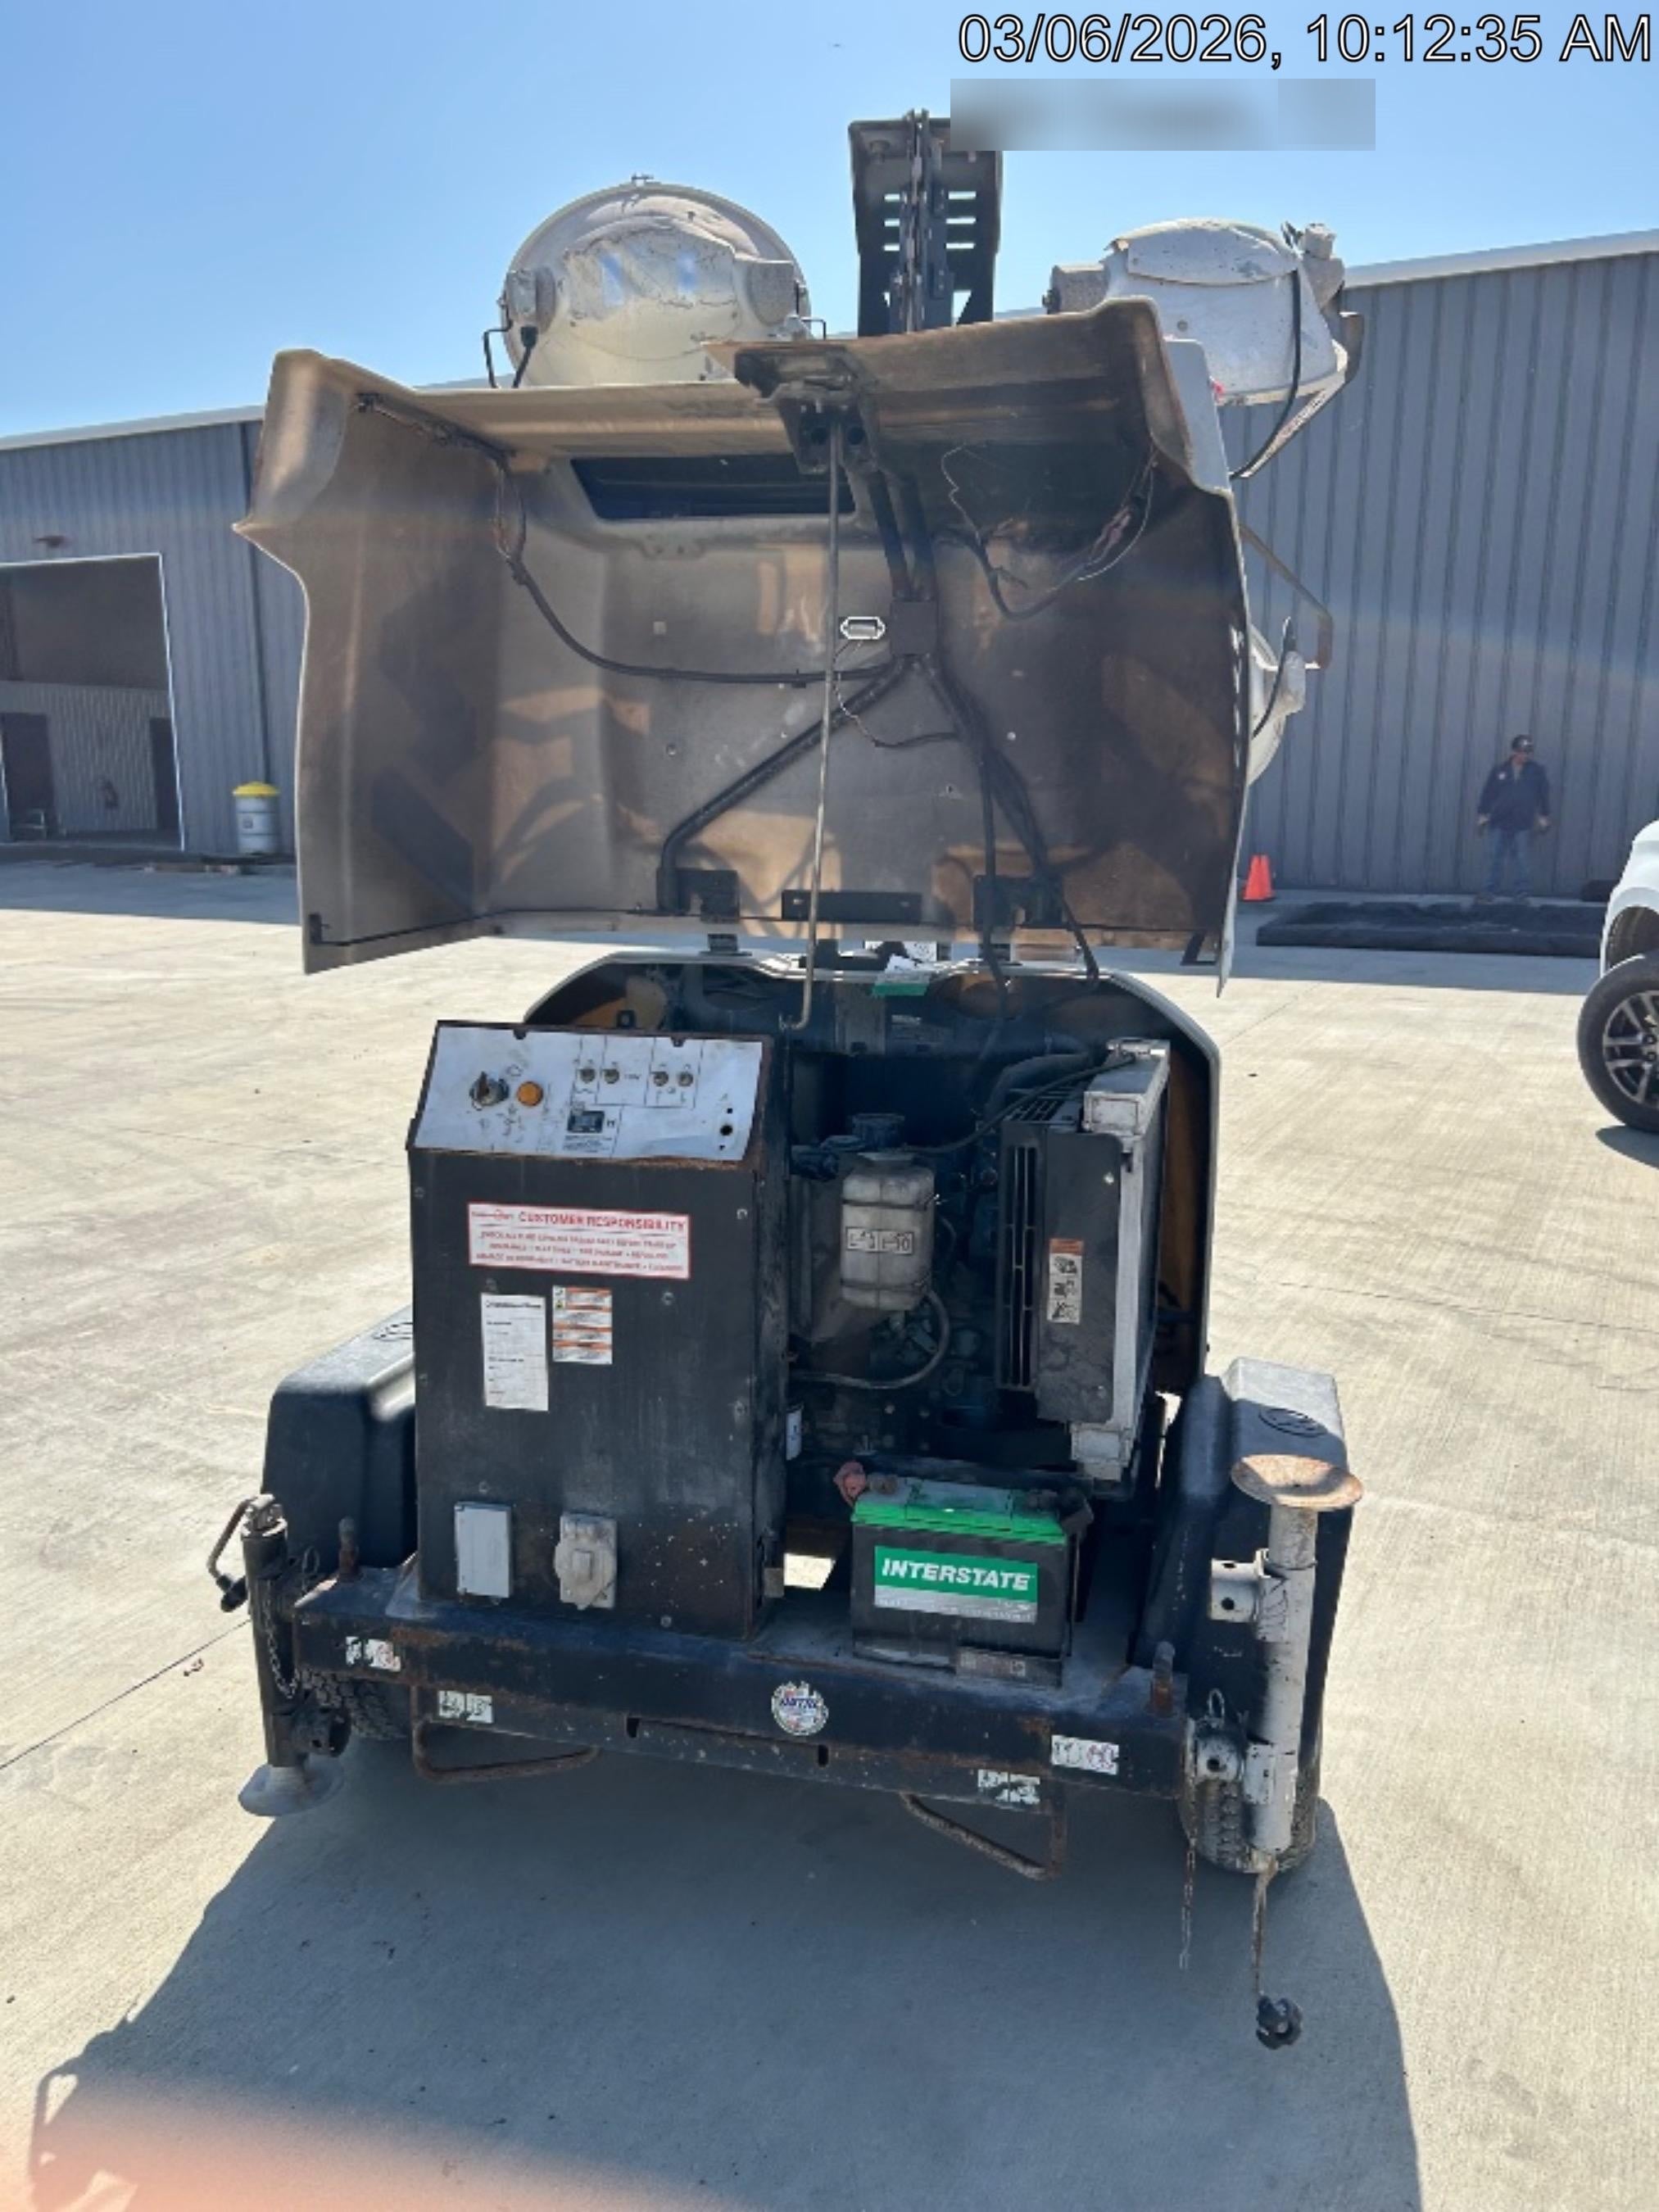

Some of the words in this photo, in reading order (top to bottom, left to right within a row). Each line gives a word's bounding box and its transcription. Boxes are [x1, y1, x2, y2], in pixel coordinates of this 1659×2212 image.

[519, 1211, 585, 1226] CUSTOMER
[587, 1215, 685, 1231] RESPONSIBILITY
[882, 1557, 1030, 1591] INTERSTATE
